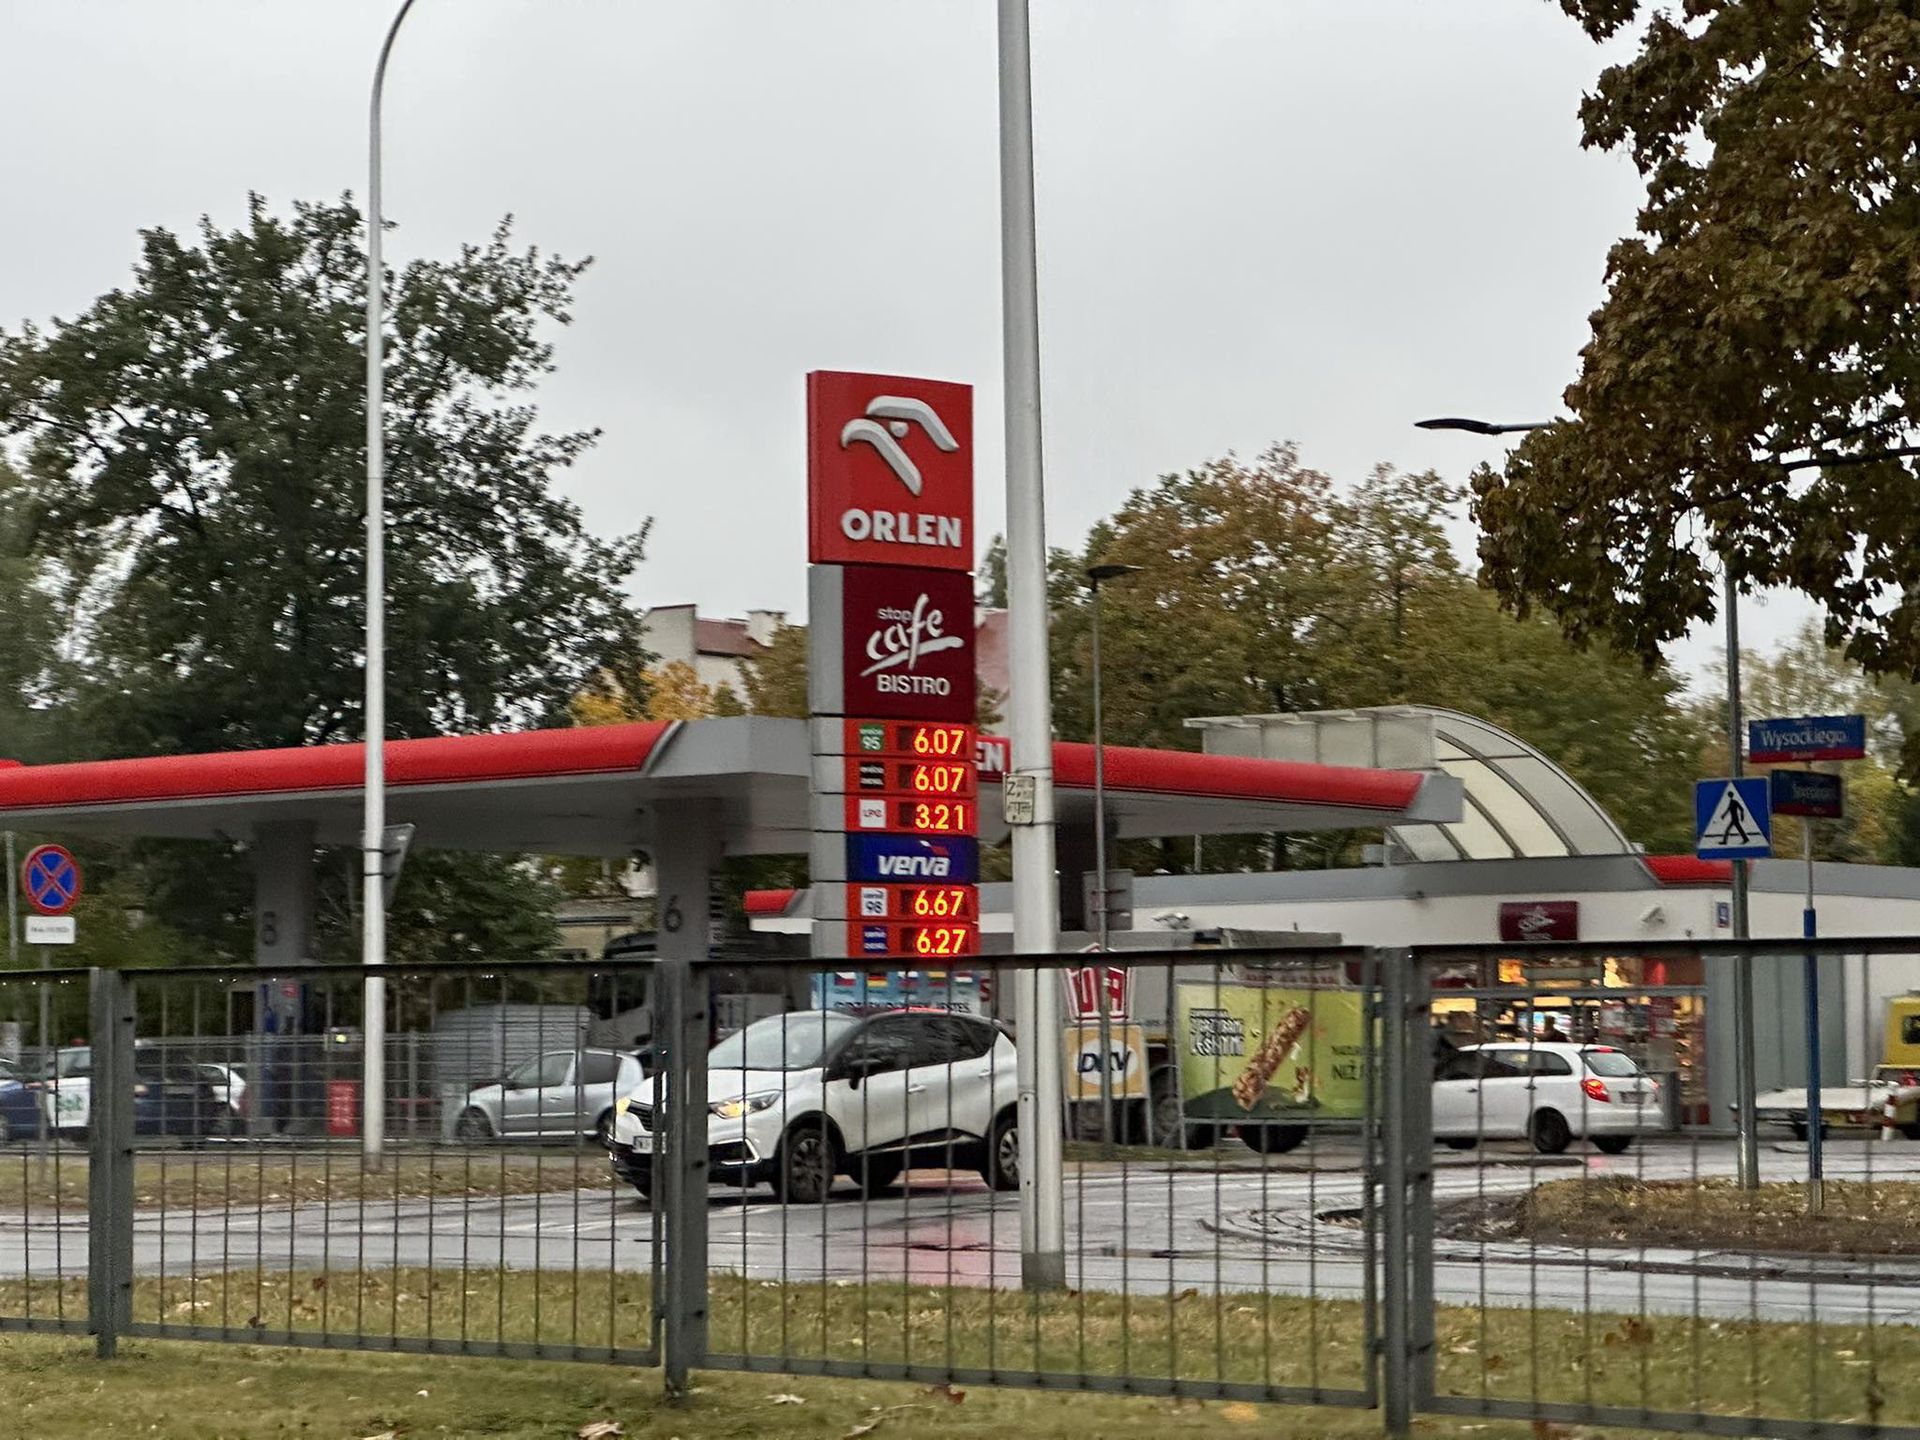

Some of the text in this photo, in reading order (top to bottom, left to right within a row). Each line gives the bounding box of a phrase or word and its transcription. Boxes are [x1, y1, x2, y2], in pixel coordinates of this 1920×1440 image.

[841, 508, 962, 548] ORLEN
[877, 607, 913, 622] stop
[866, 594, 944, 670] cafe
[877, 674, 951, 696] BISTRO
[914, 727, 965, 755] 6.07
[1761, 727, 1847, 750] Wysockiego
[914, 766, 965, 793] 6.07
[915, 803, 964, 830] 3.21
[877, 855, 951, 877] verva
[664, 895, 682, 933] 6
[866, 889, 965, 917] 98 6.67
[916, 928, 967, 955] 6.27
